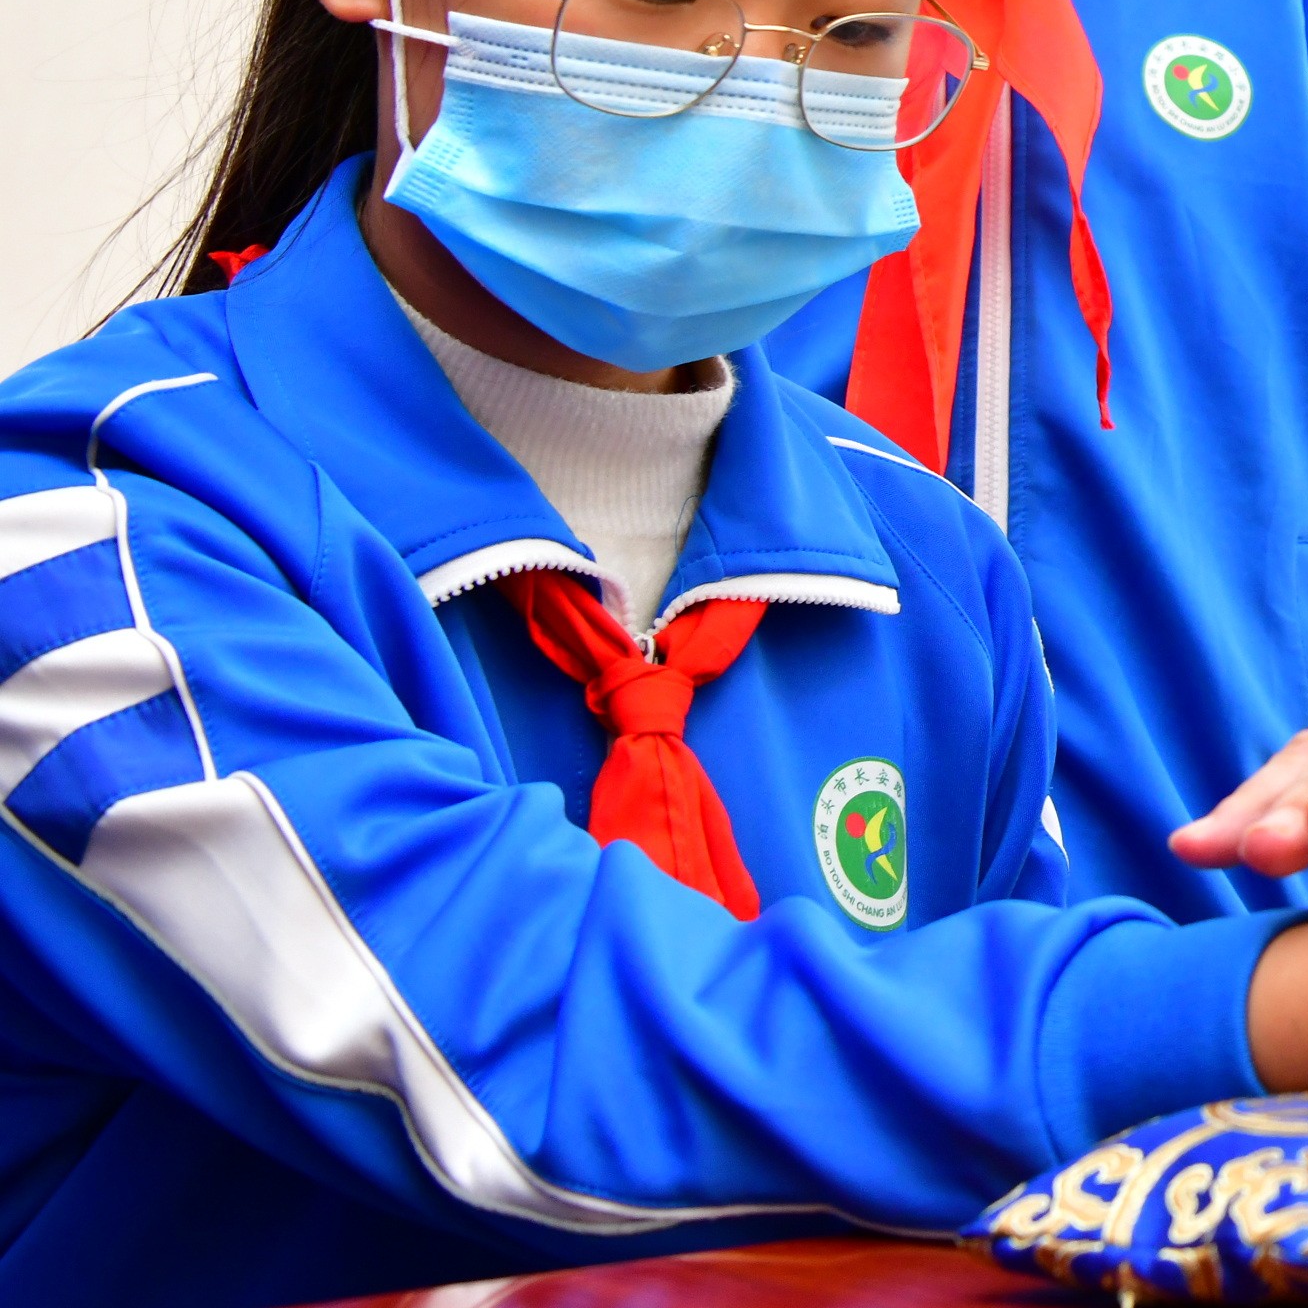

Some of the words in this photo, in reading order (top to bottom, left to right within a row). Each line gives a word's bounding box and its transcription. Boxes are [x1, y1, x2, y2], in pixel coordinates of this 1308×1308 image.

[823, 849, 832, 866] BO
[829, 868, 843, 890] TOU
[842, 889, 855, 905] SHI
[856, 901, 884, 918] CHANG
[886, 906, 896, 918] AN
